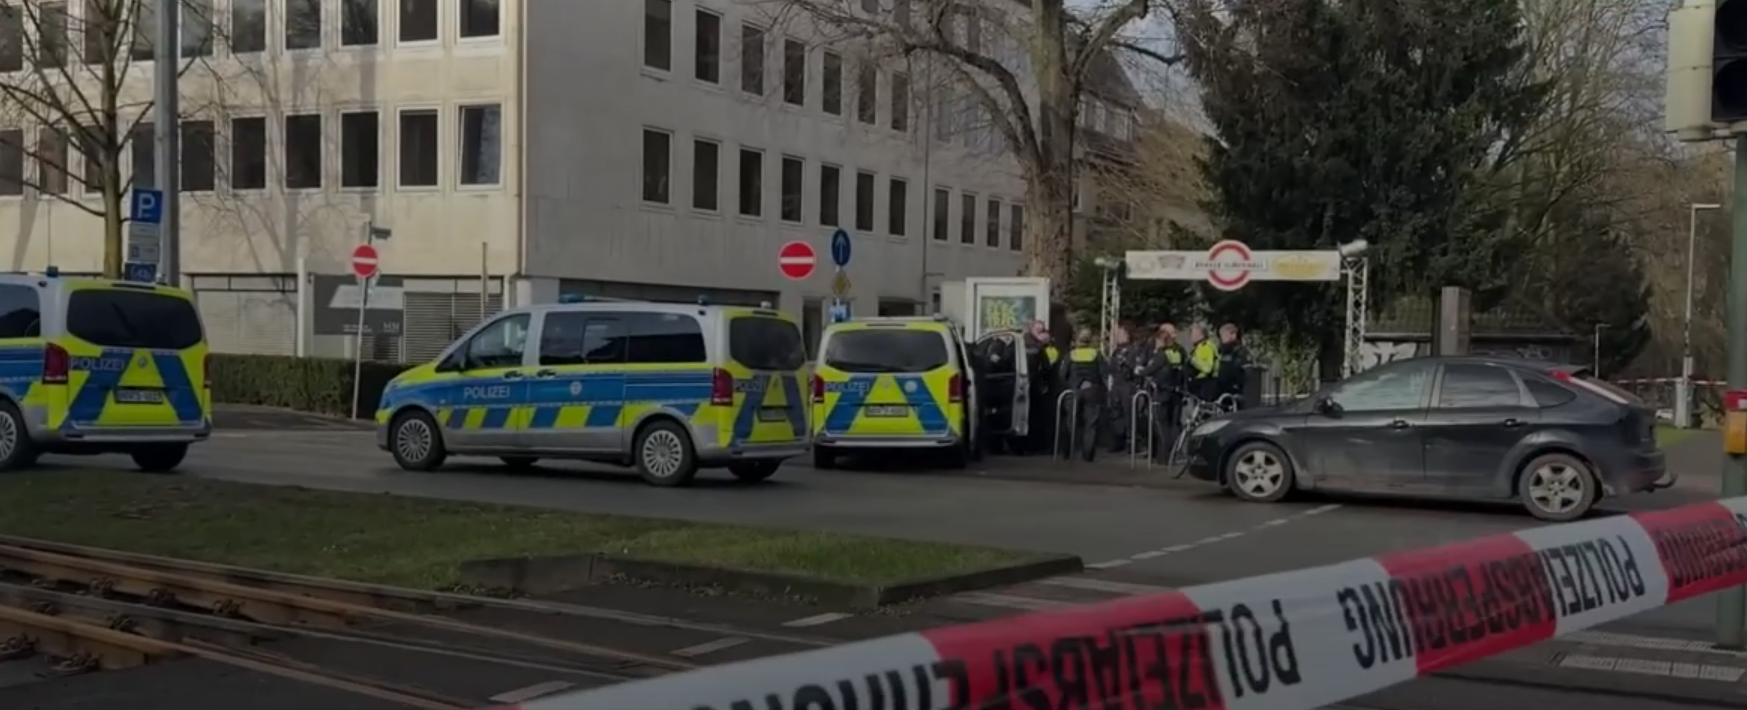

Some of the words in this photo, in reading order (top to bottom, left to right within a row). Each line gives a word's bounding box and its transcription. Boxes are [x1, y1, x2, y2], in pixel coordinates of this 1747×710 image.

[137, 192, 156, 219] P
[70, 357, 125, 372] POLIZEI
[463, 385, 511, 399] POLIZEI
[824, 381, 870, 392] POLIZEI
[1336, 534, 1645, 669] POLIZEIABSPERRUNG
